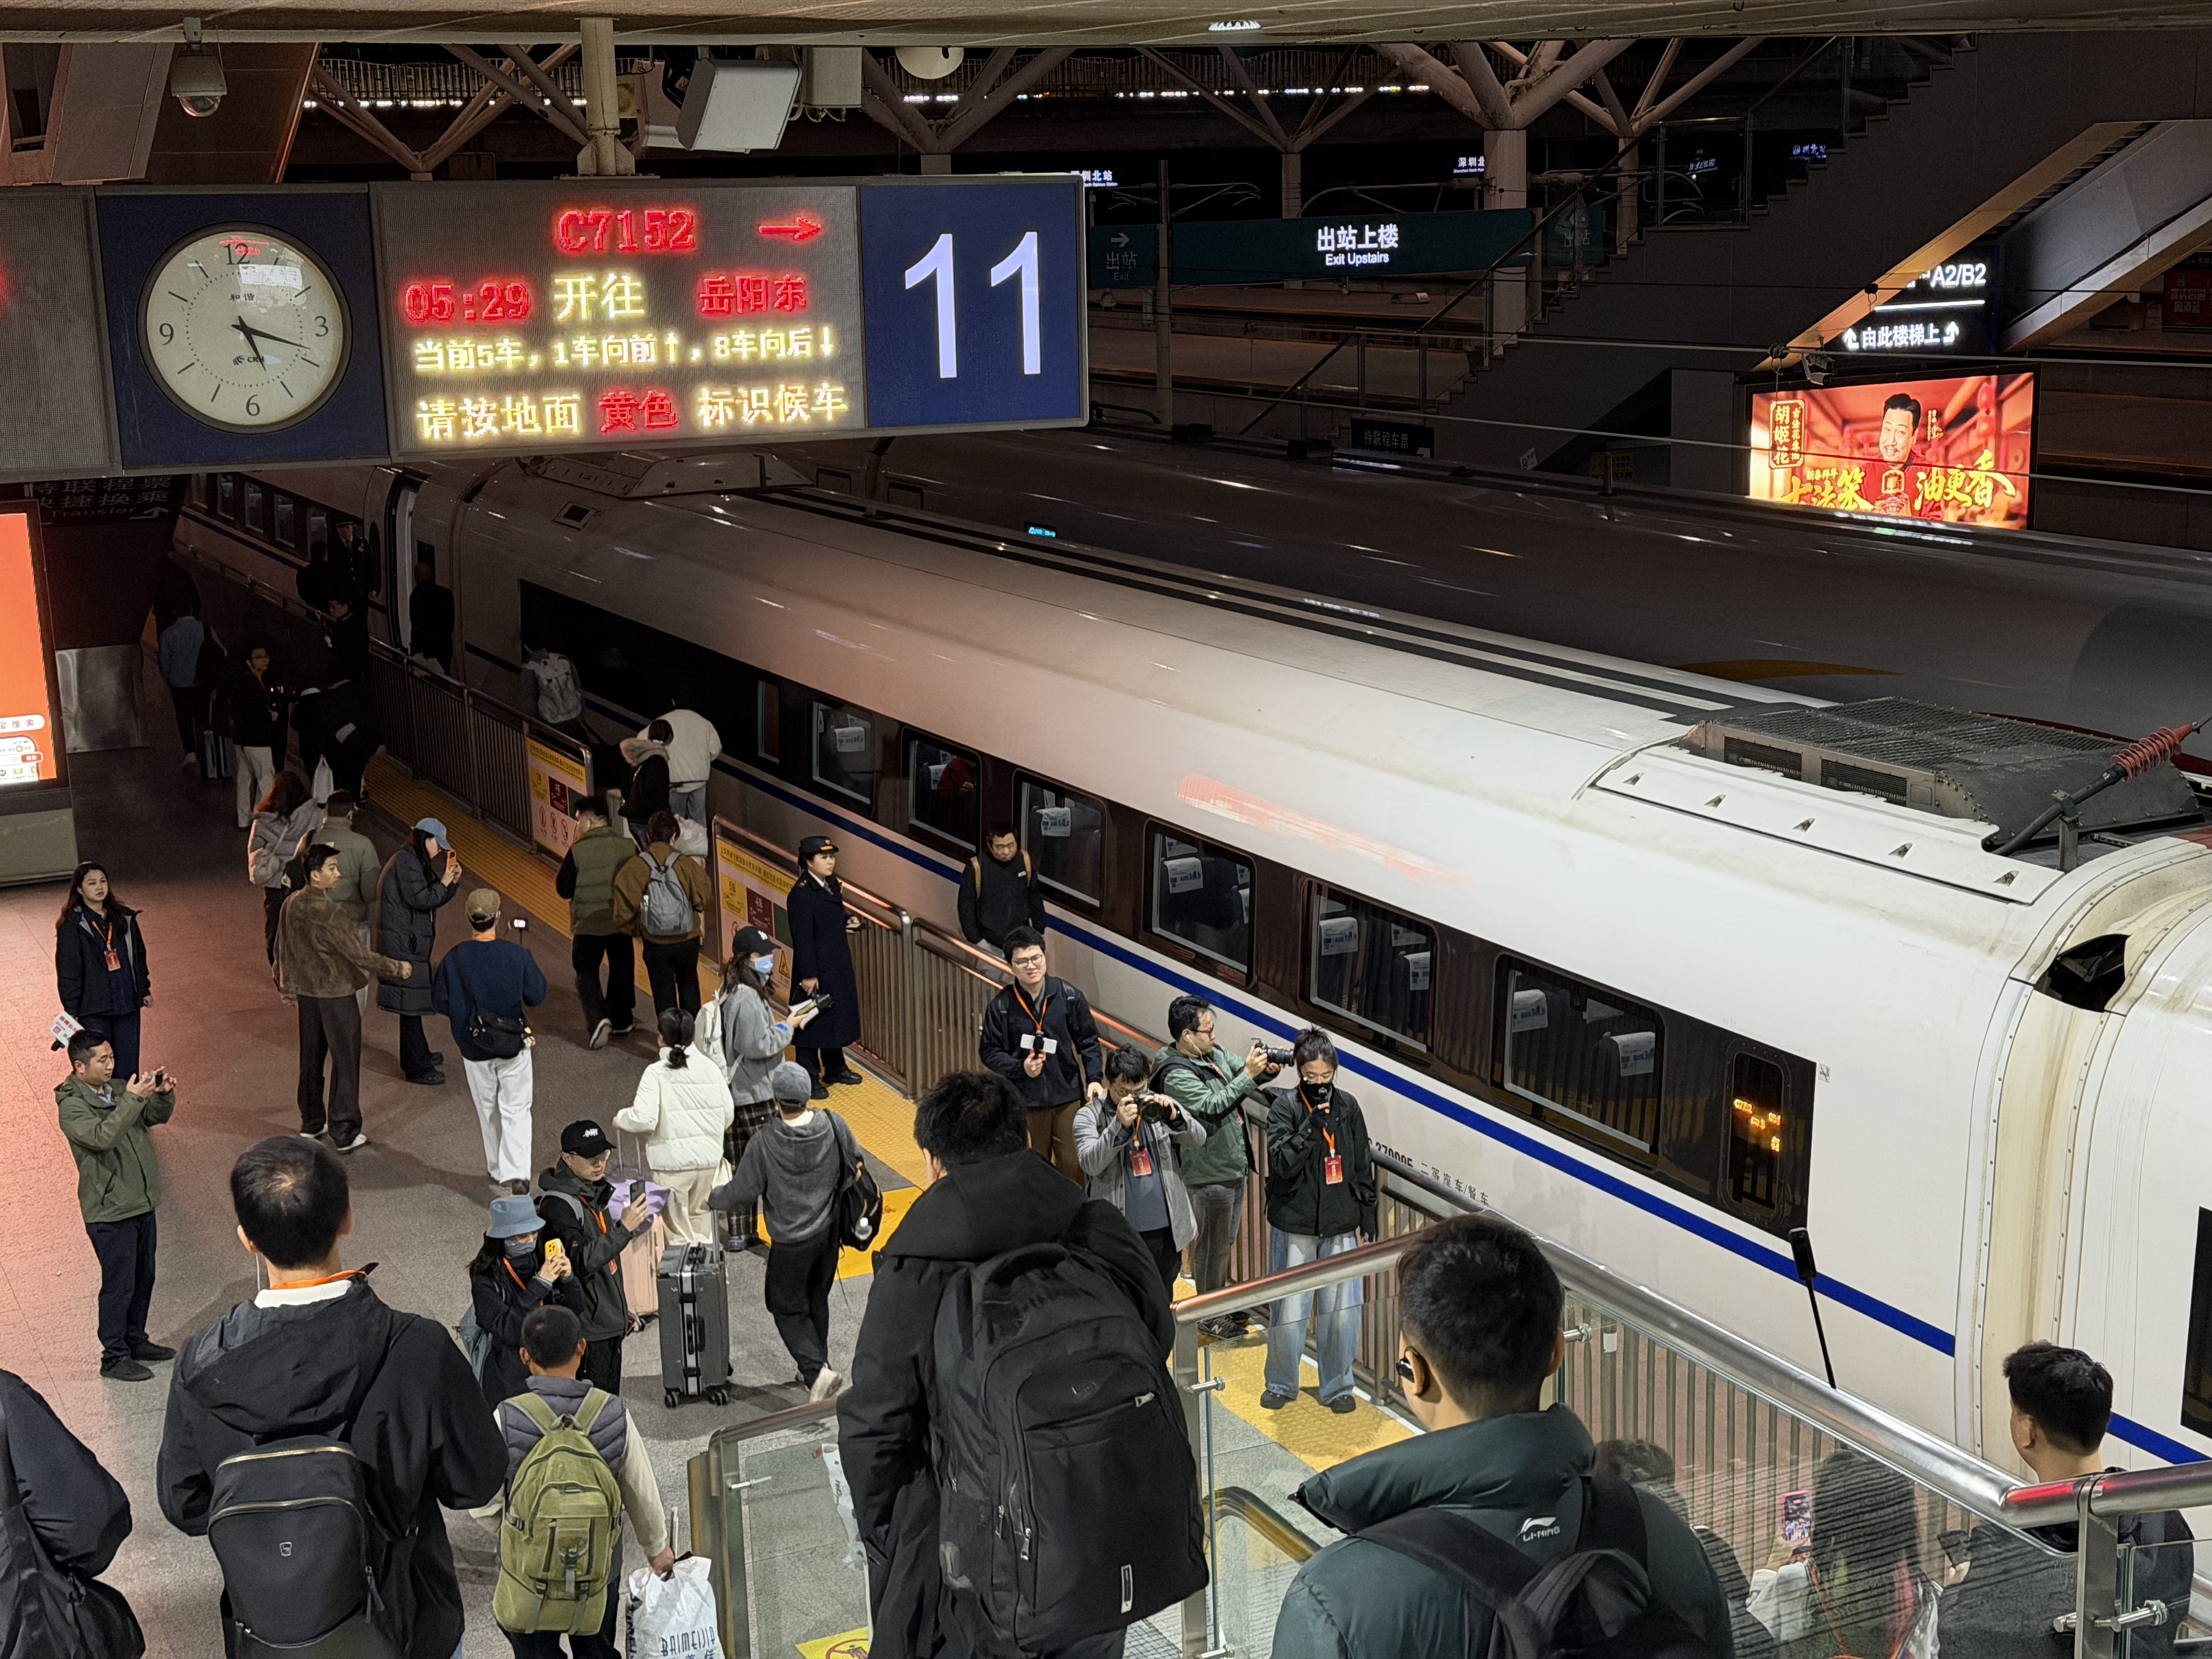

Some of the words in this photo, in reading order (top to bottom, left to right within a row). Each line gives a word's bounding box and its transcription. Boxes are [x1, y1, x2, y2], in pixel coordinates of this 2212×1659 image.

[558, 210, 696, 252] C7152
[1317, 223, 1398, 252] 出站上楼
[223, 244, 250, 265] 12
[1107, 251, 1138, 270] 出站
[1325, 253, 1345, 266] Exit
[1347, 251, 1390, 267] Upstairs
[1930, 263, 1987, 289] A2/B2
[229, 293, 255, 302] 和谐
[405, 283, 531, 321] 05:29
[552, 273, 646, 322] 开往
[698, 273, 808, 314] 岳阳东
[905, 232, 1041, 379] 11
[159, 323, 174, 346] 9
[314, 315, 329, 337] 3
[1861, 323, 1940, 350] 由此楼梯上
[246, 394, 261, 416] 6
[416, 393, 581, 440] 请按地面
[599, 390, 679, 433] 黄色
[697, 382, 848, 428] 标识候车
[1364, 428, 1409, 450] 持联程车票
[1773, 405, 1790, 465] 胡姬花
[1791, 407, 1801, 461] 古法花生油
[1805, 467, 1838, 481] 新春拜年
[1914, 449, 2017, 511] 油更香
[1420, 1162, 1489, 1206] 二等座车/餐车
